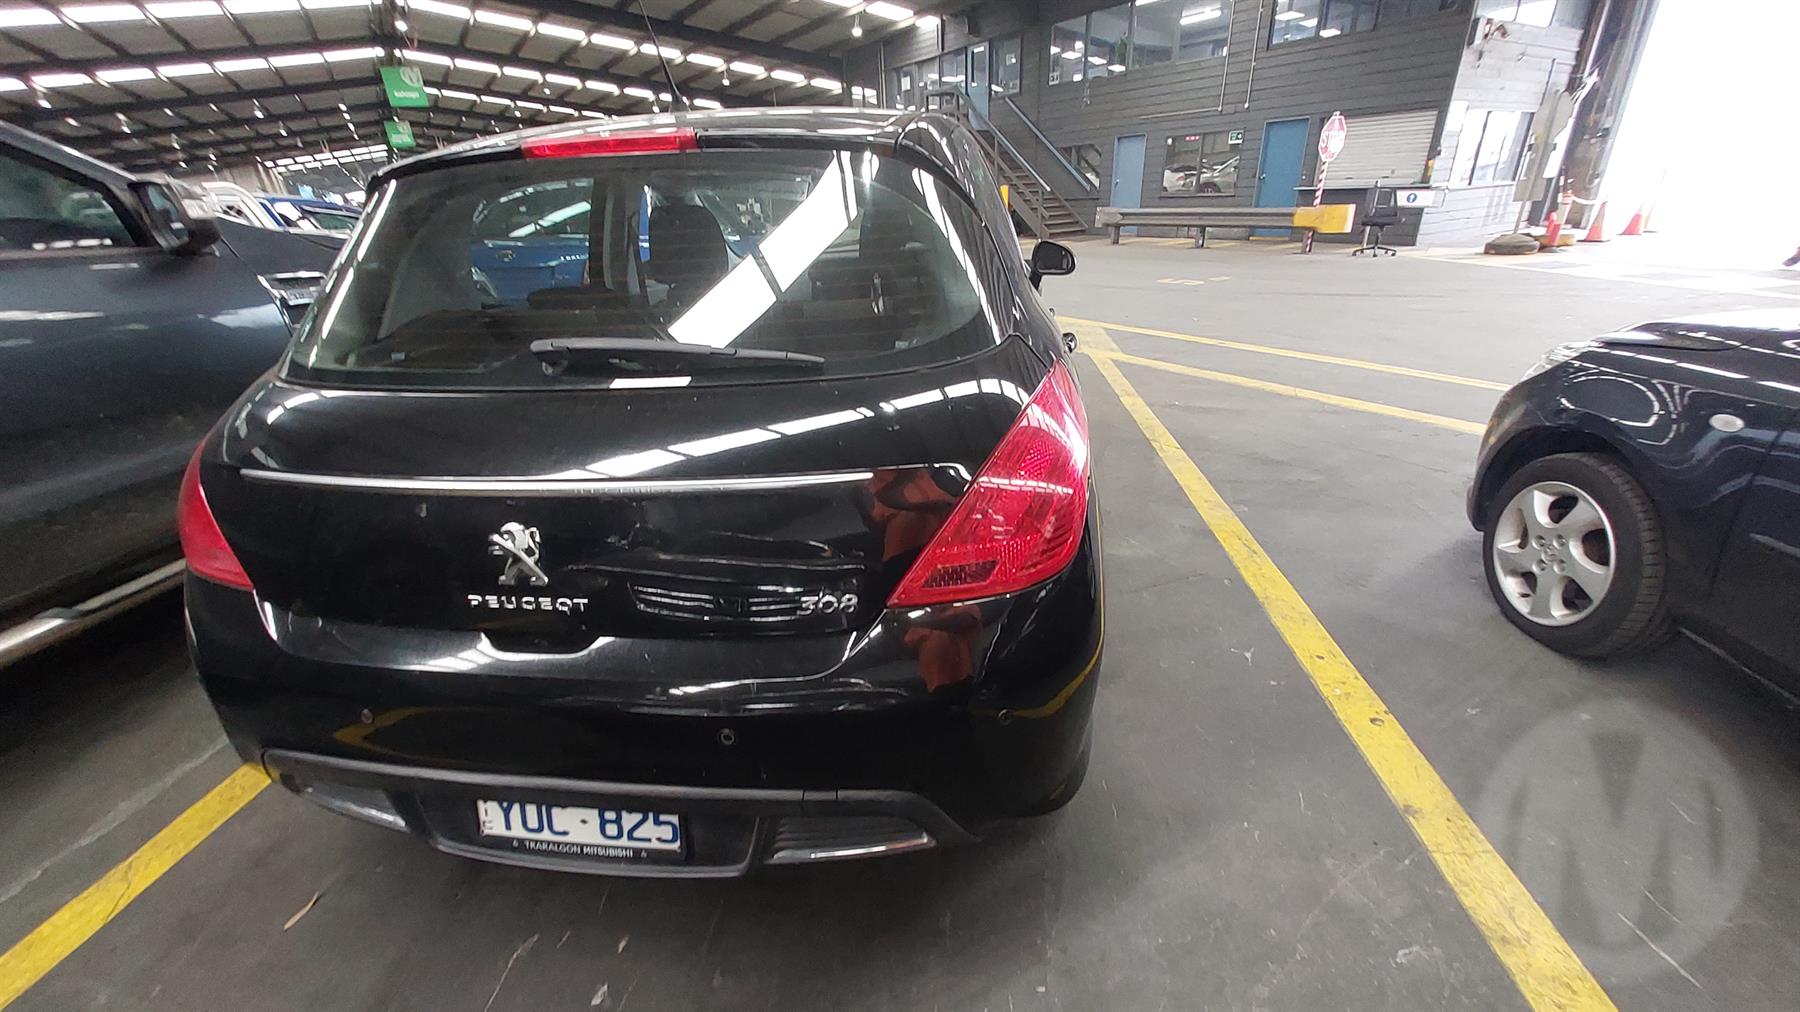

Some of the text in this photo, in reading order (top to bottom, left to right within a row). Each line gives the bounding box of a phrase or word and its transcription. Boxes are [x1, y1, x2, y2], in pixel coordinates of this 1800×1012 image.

[1321, 129, 1345, 148] STOP
[467, 594, 589, 614] PEUGEOT
[797, 593, 859, 616] 308
[583, 845, 633, 859] MITSUBISHI
